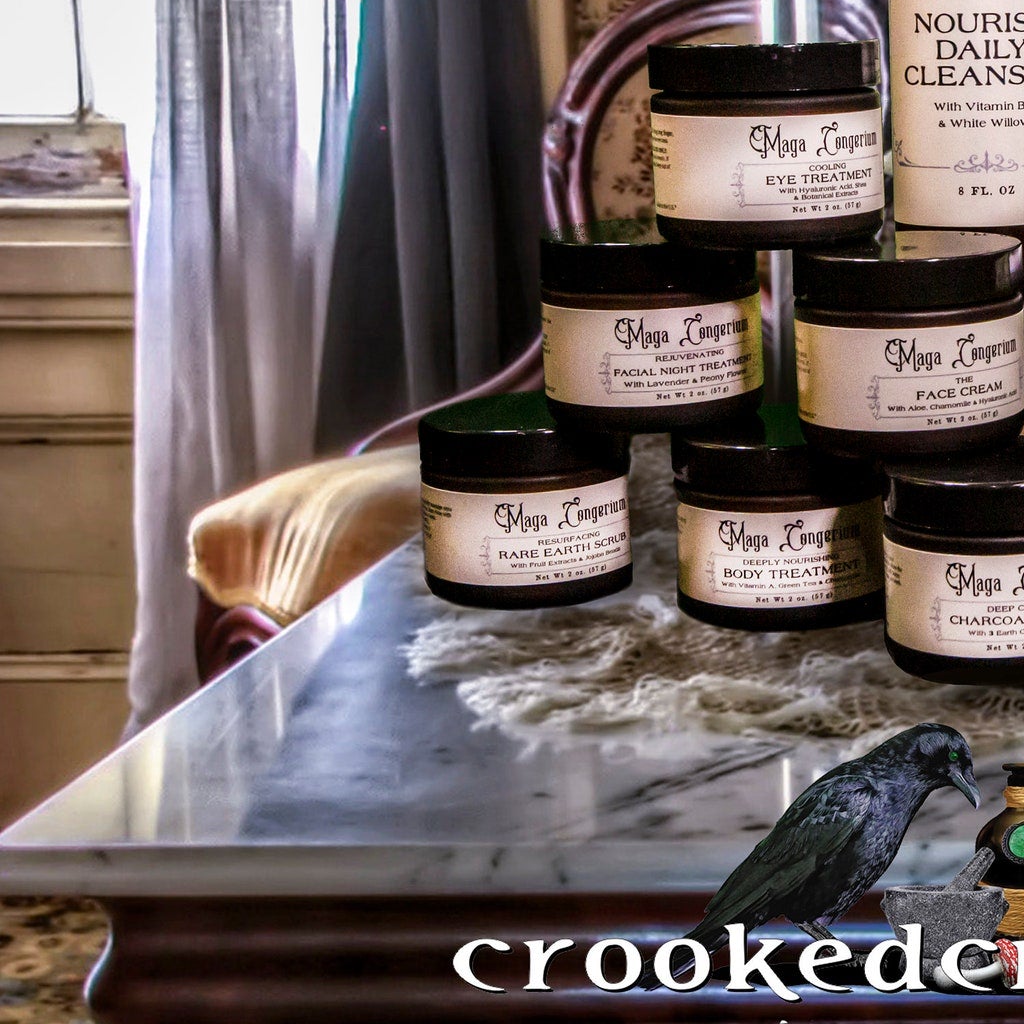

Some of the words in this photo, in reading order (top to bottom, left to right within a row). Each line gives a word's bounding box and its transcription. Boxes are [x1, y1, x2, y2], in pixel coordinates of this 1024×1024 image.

[934, 102, 961, 111] With
[966, 102, 1014, 111] Vitamin
[950, 119, 986, 128] White
[749, 124, 807, 159] Maga
[809, 163, 846, 171] COOLING
[766, 175, 796, 185] EYE
[801, 168, 872, 184] TREATMENT
[799, 185, 837, 195] Hyaluronic
[801, 192, 833, 200] Botanical
[835, 190, 858, 198] Extracts
[958, 187, 964, 195] 8
[971, 186, 992, 196] FL.
[1000, 186, 1015, 195] OZ
[614, 317, 669, 350] Maga
[655, 349, 724, 362] REJUVENATING
[885, 338, 942, 372] Maga
[614, 369, 656, 377] FACIAL
[660, 366, 695, 375] NIGHT
[647, 378, 689, 387] Lavender
[701, 373, 725, 383] Peony
[955, 376, 973, 384] THE
[917, 389, 956, 400] FACE
[960, 381, 1003, 397] CREAM
[930, 400, 971, 410] Chamomile
[494, 502, 548, 533] Maga
[538, 530, 600, 546] RESURFACING
[718, 520, 769, 553] Maga
[499, 550, 539, 559] RARE
[544, 544, 590, 557] EARTH
[594, 532, 626, 549] SCRUB
[548, 557, 577, 567] Extracts
[724, 568, 763, 579] BODY
[769, 559, 860, 579] TREATMENT
[945, 563, 1001, 597] Maga
